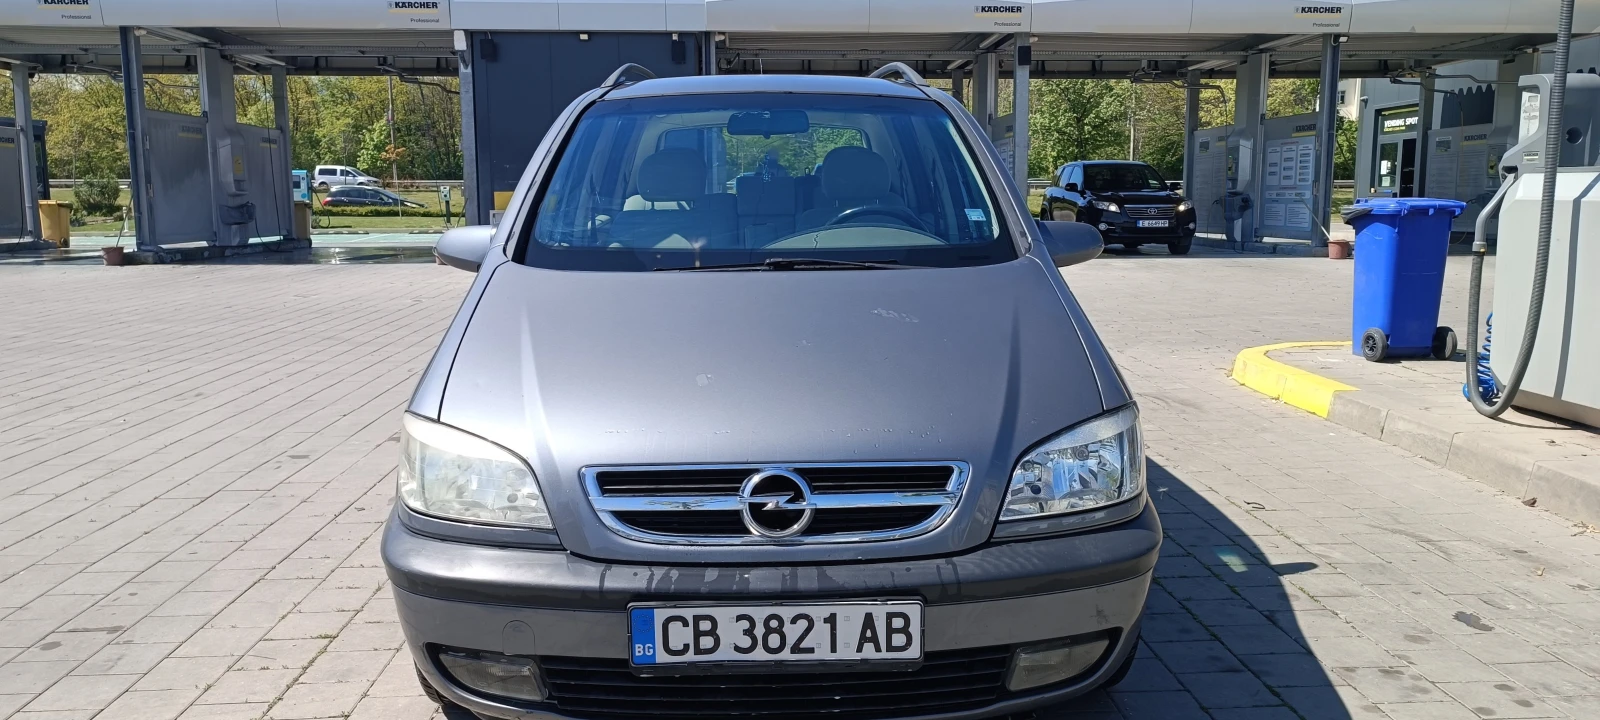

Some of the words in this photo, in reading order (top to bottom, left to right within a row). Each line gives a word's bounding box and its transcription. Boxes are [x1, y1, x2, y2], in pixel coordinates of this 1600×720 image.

[1384, 119, 1405, 128] VENDING
[1405, 117, 1419, 125] SPOT
[661, 614, 721, 657] CB
[733, 613, 838, 656] 3821
[855, 611, 914, 654] AB
[635, 643, 654, 657] BG
